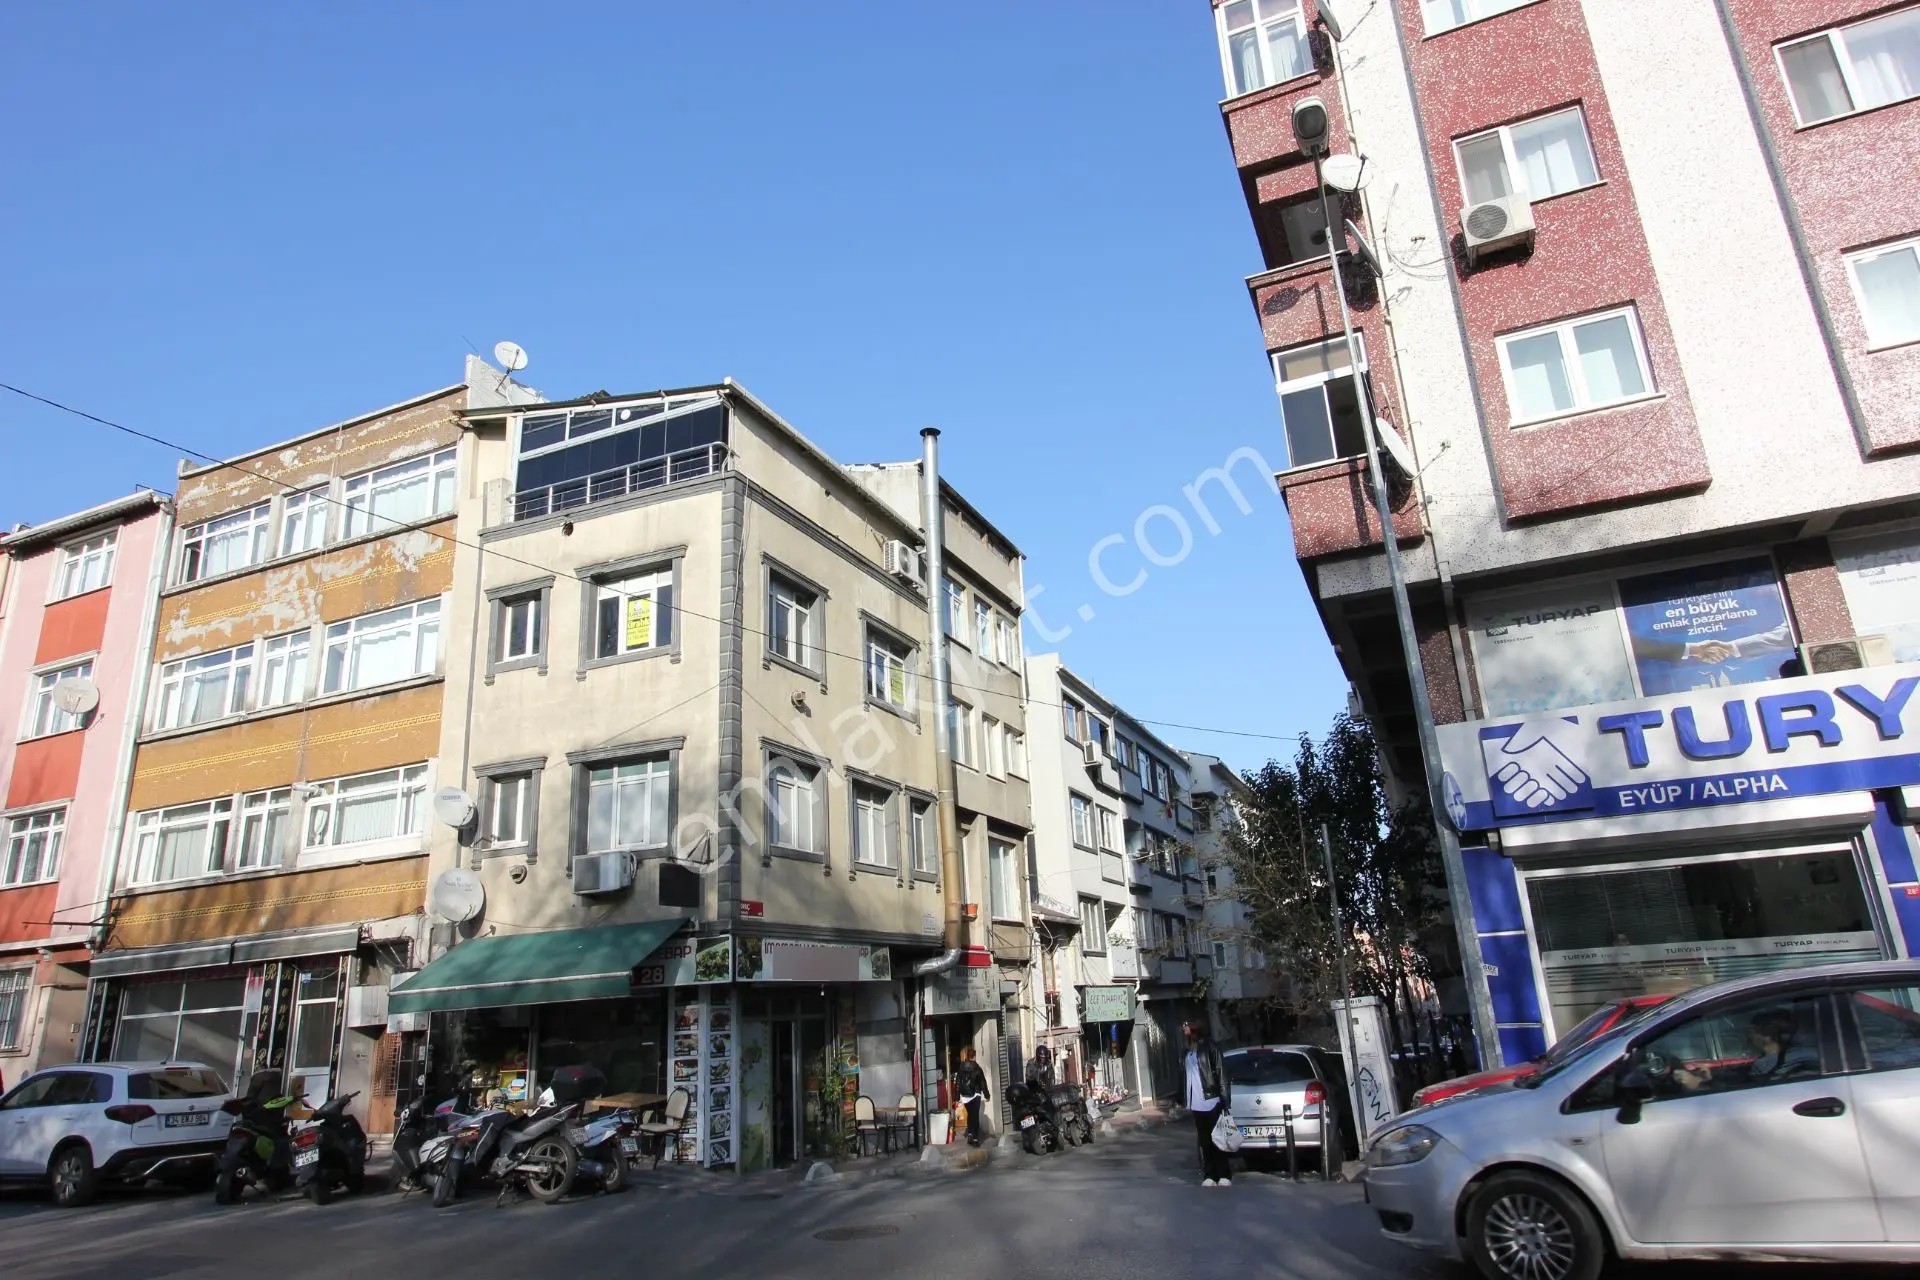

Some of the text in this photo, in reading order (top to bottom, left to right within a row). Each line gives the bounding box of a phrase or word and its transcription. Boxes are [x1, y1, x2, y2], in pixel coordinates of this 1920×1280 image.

[1512, 604, 1601, 628] TURYAP
[1665, 598, 1739, 618] en büyük
[1652, 608, 1758, 630] emlak pazarlama
[1688, 622, 1727, 636] zinciri.
[1619, 783, 1683, 808] EYÜP
[1702, 774, 1788, 800] ALPHA
[1664, 945, 1702, 954] TURYAP
[1773, 939, 1813, 948] TURYAP
[641, 967, 663, 984] 28
[1243, 1127, 1251, 1136] 34
